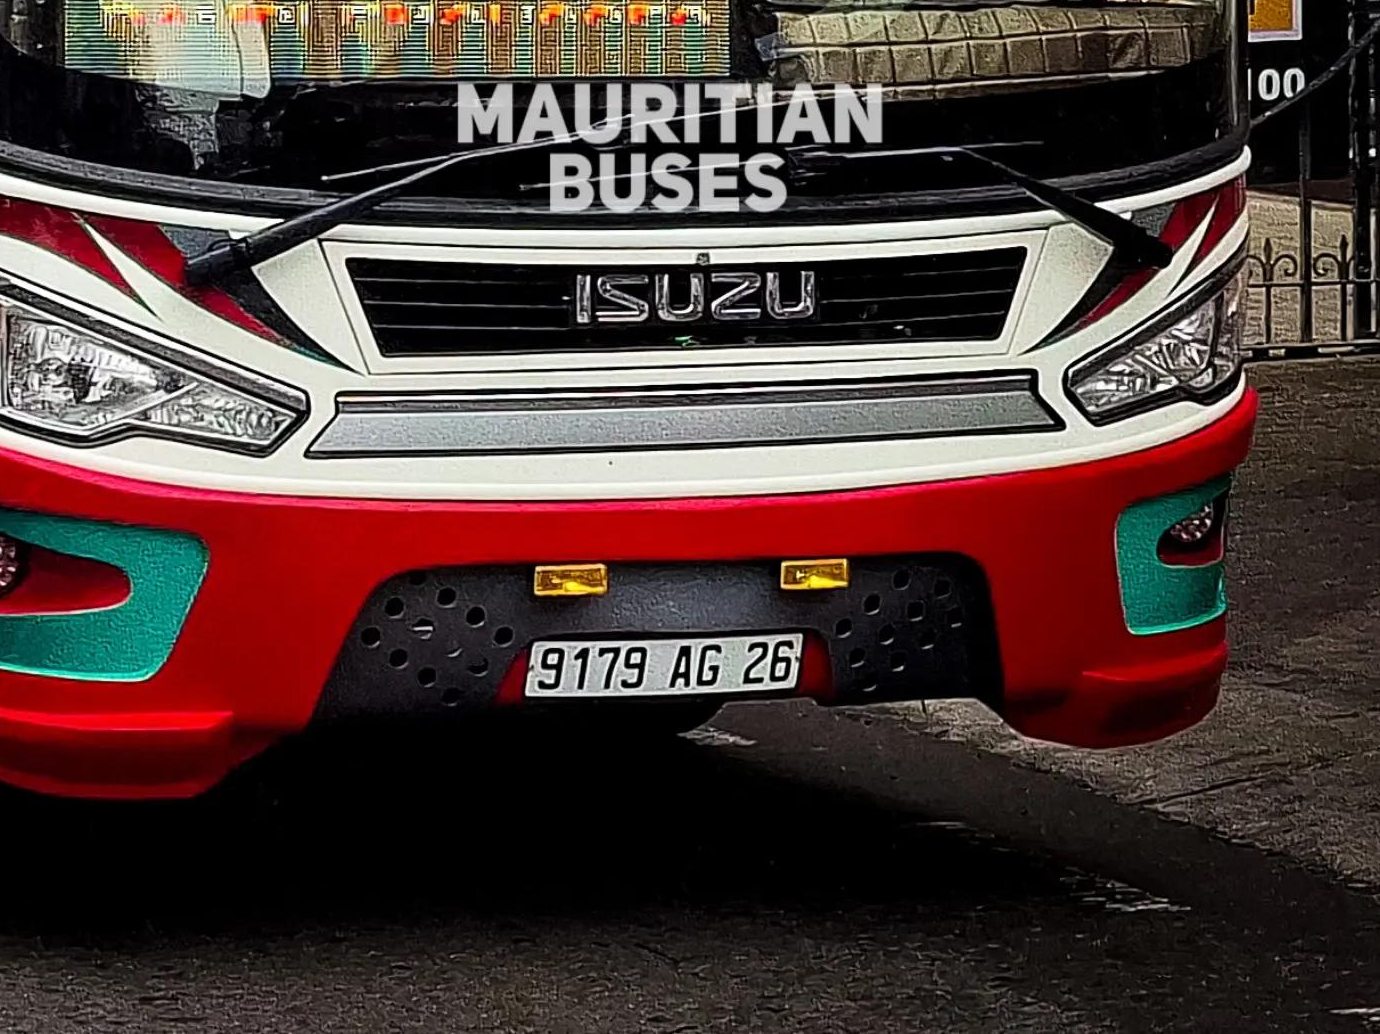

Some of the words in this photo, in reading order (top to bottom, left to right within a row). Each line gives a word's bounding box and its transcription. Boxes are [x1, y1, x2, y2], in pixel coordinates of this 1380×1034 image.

[575, 271, 816, 324] ISUZU
[537, 647, 648, 690] 9179
[669, 644, 722, 688] AG
[742, 640, 794, 684] 26
